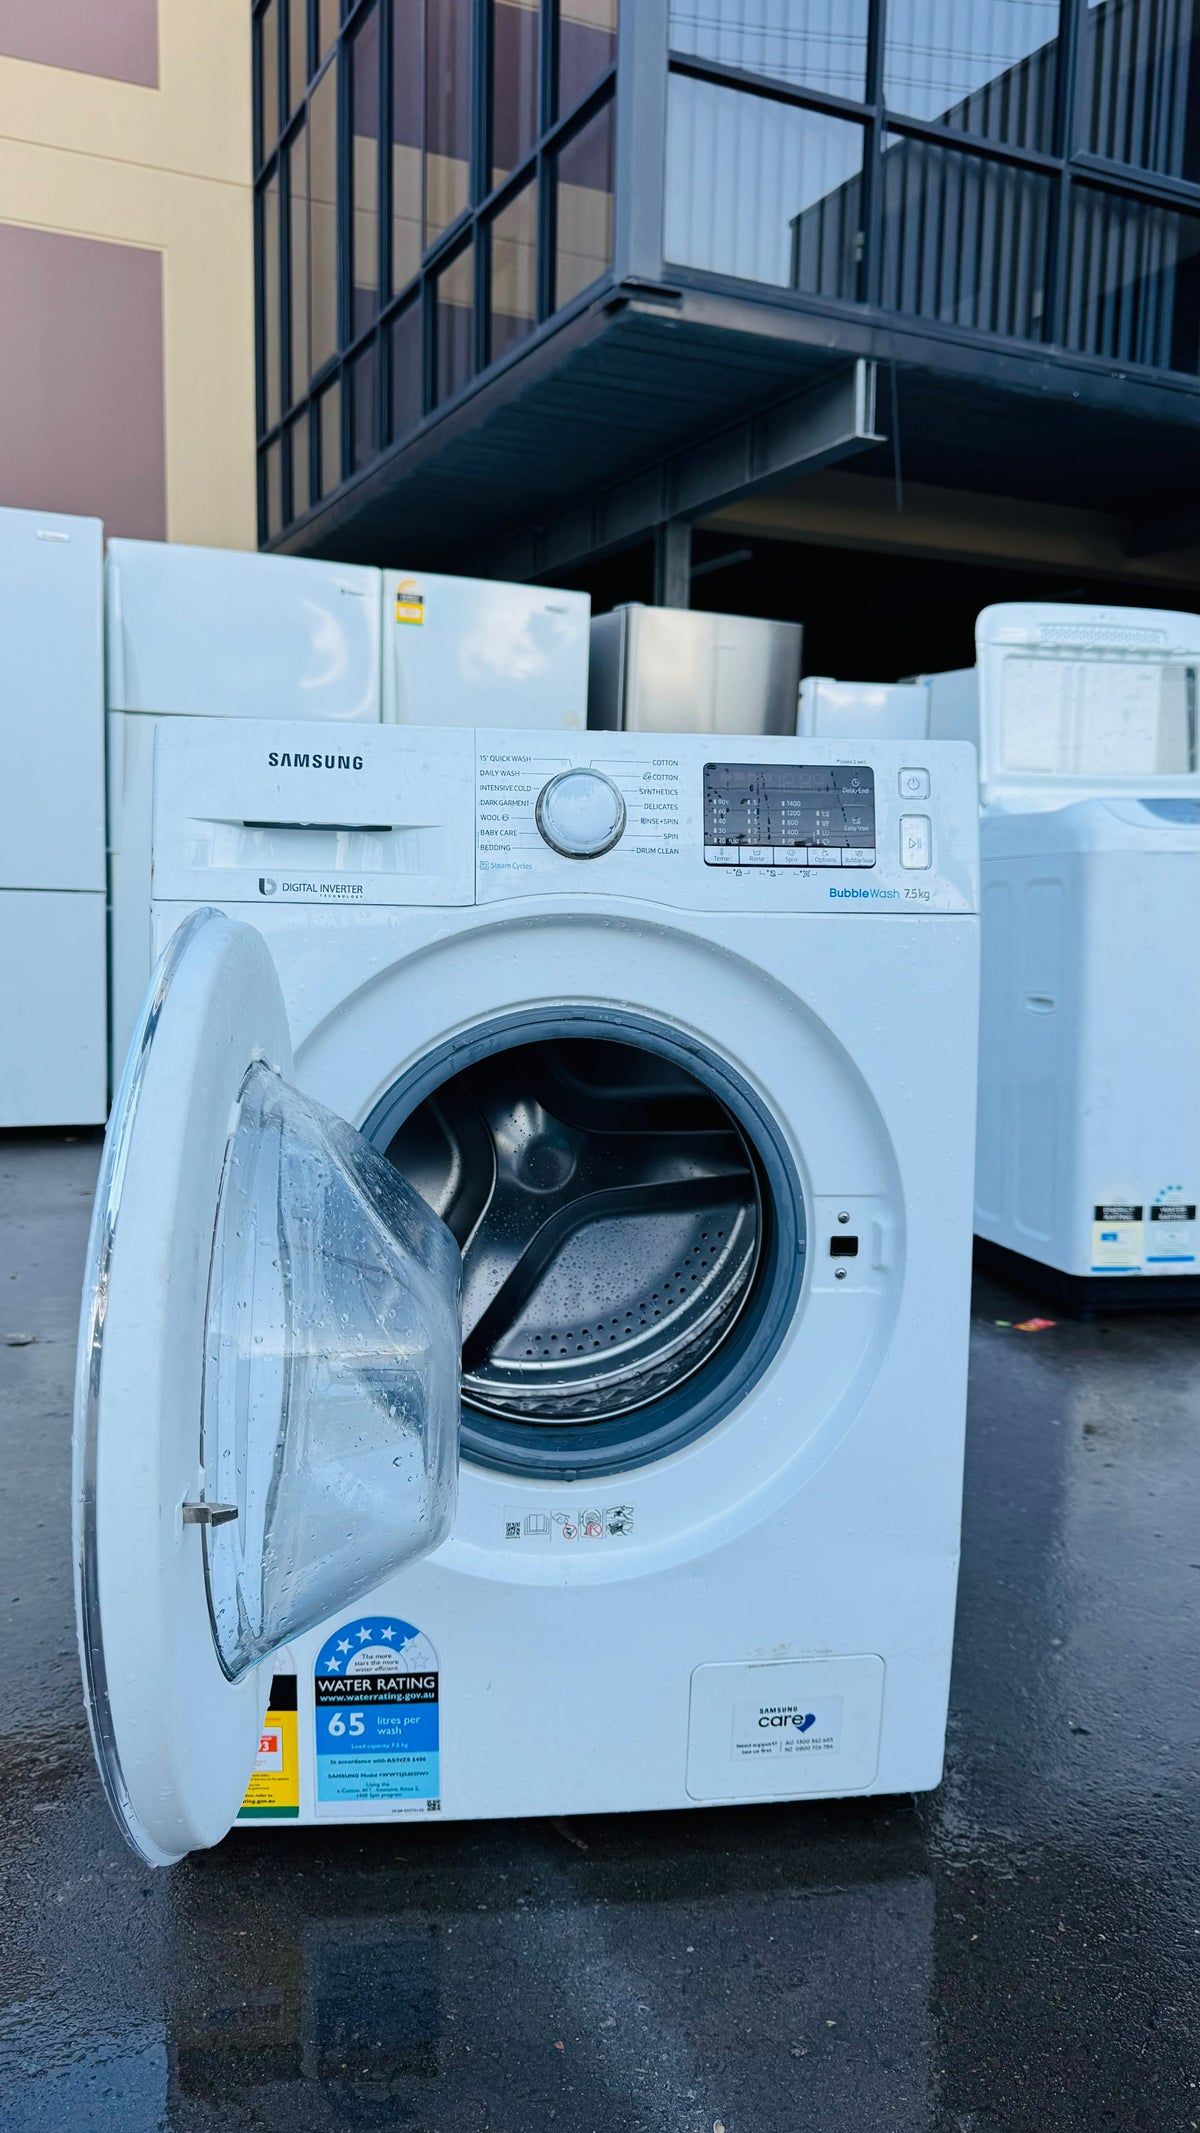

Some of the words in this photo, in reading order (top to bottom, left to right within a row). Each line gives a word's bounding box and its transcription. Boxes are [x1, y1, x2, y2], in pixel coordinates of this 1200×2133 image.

[268, 752, 363, 770] SAMSUNG
[639, 788, 679, 796] SYNTHETICS
[815, 856, 837, 864] Options
[512, 862, 532, 870] Cycles
[282, 882, 318, 892] DIGITAL
[320, 884, 363, 894] INVERTER
[318, 1679, 372, 1692] WATER
[377, 1676, 435, 1691] RATING
[320, 1691, 435, 1702] www.waterrating.gov.au
[759, 1706, 798, 1714] SAMSUNG
[328, 1712, 365, 1736] 65
[377, 1716, 401, 1725] litres
[404, 1716, 421, 1726] per
[758, 1714, 804, 1728] care
[377, 1726, 402, 1735] wash
